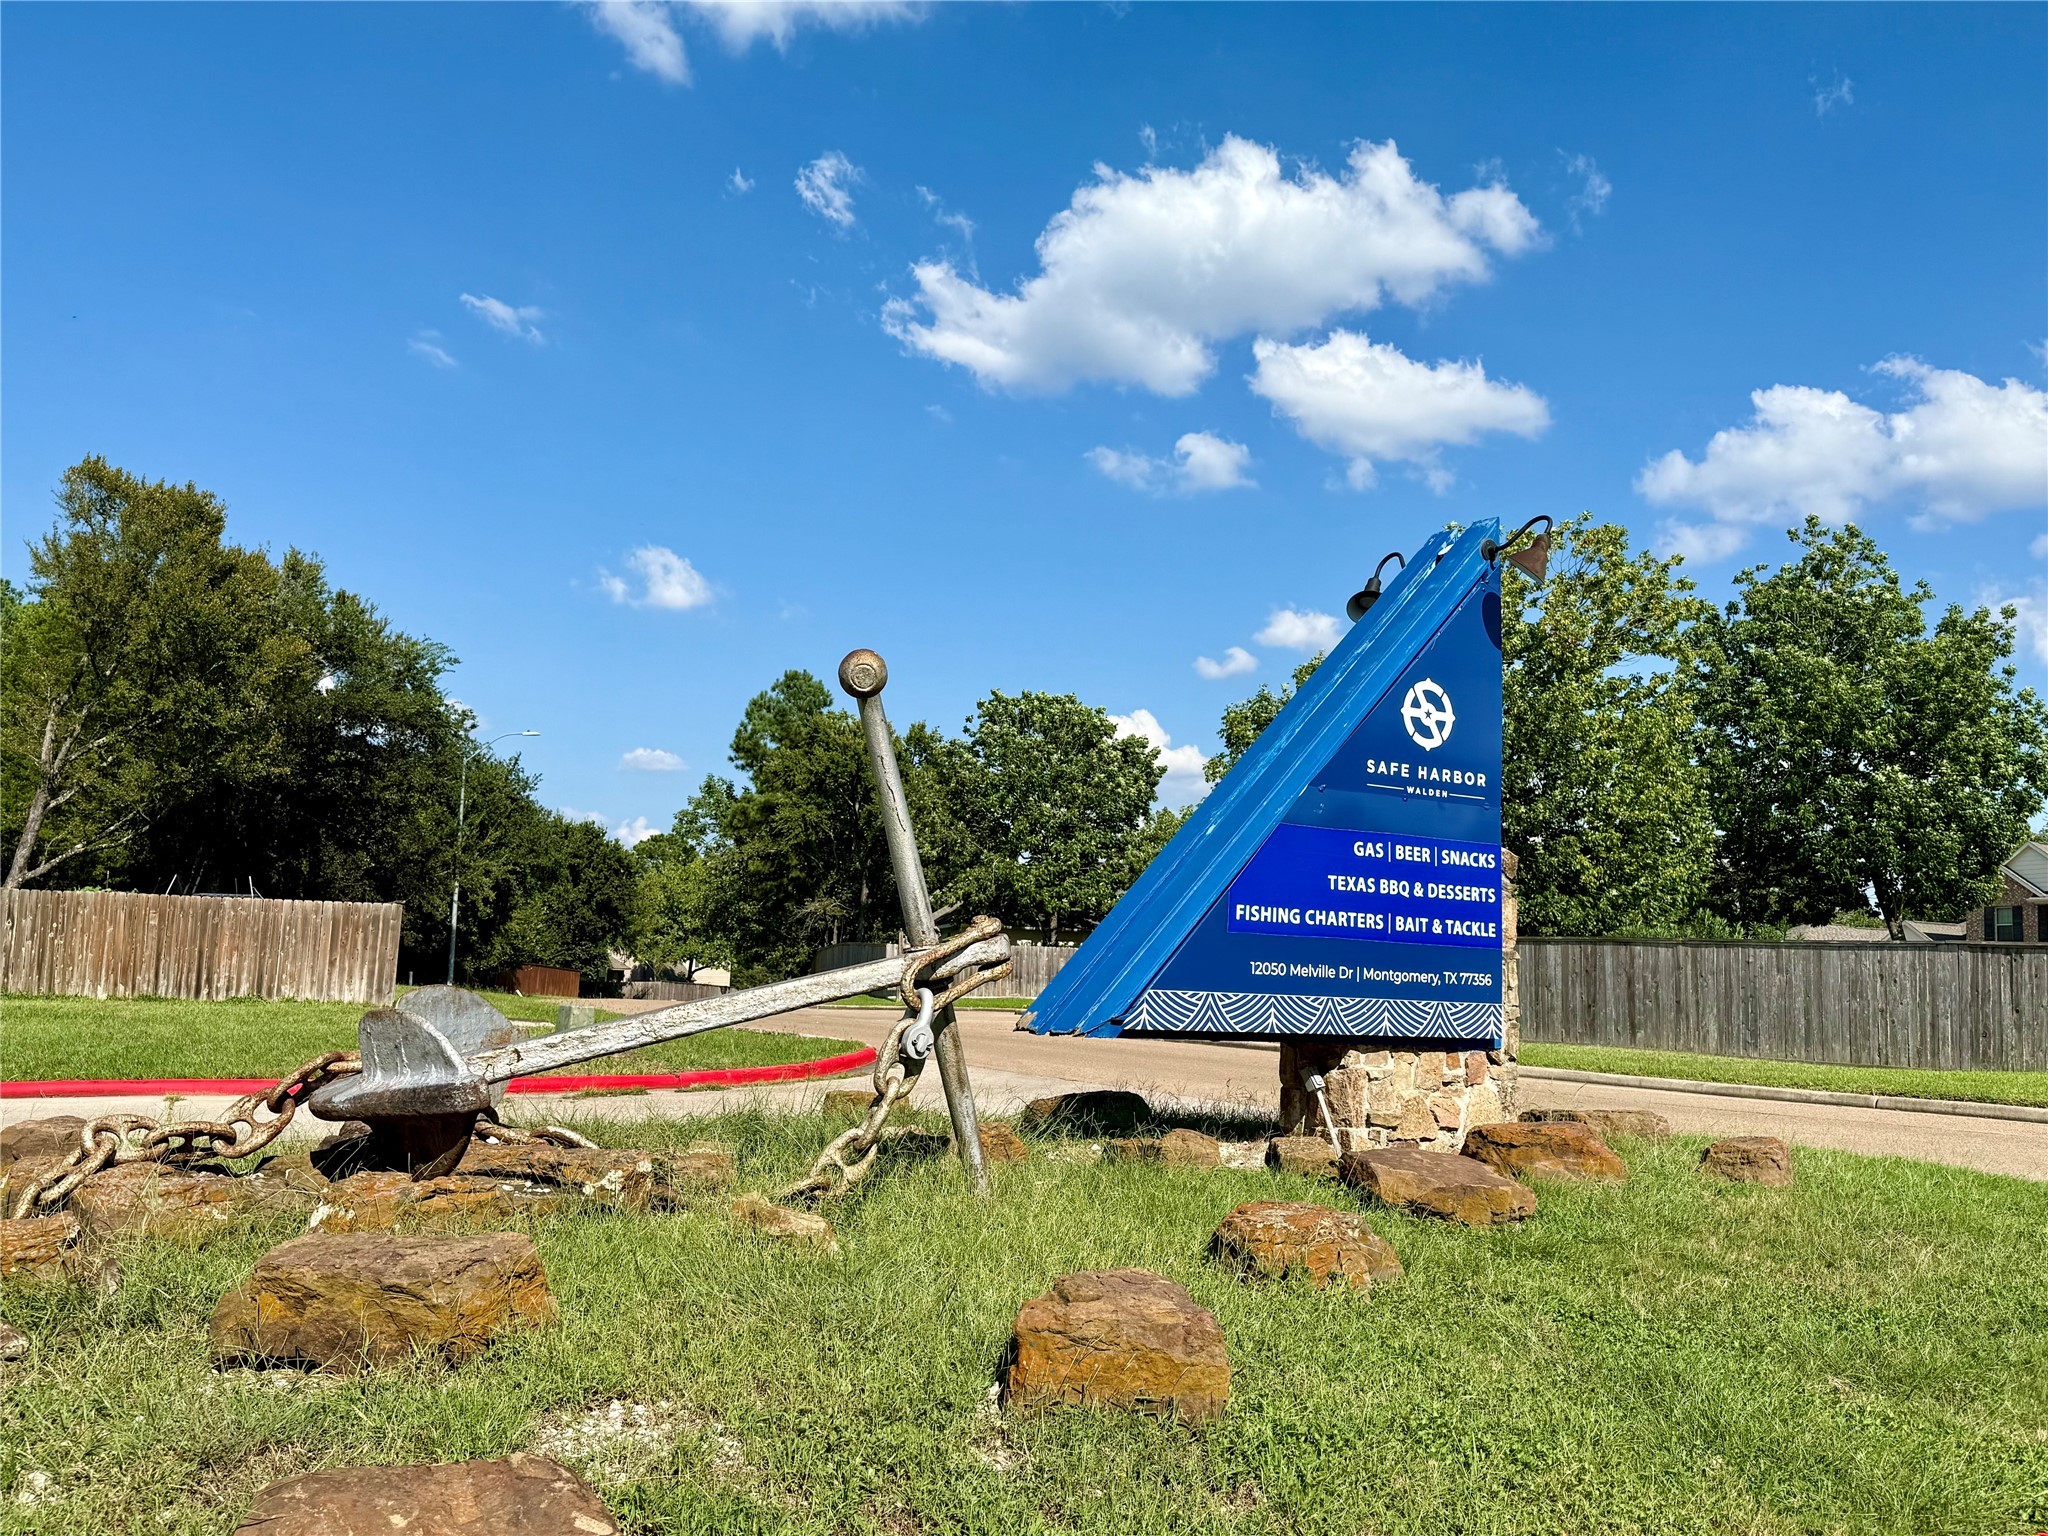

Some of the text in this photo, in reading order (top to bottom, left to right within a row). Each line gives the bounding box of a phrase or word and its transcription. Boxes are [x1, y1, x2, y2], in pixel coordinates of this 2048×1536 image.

[1367, 760, 1486, 787] SAFE HARBOR
[1407, 786, 1447, 797] WALDEN
[1354, 842, 1495, 868] GAS BEER SNACKS
[1328, 875, 1495, 903] TEXAS BBQ & DESSERTS
[1236, 904, 1496, 937] FISHING CHARTERS BAIT & TACKLE
[1250, 962, 1492, 986] 12050 Melville Dr Montgomery, TX 77356
